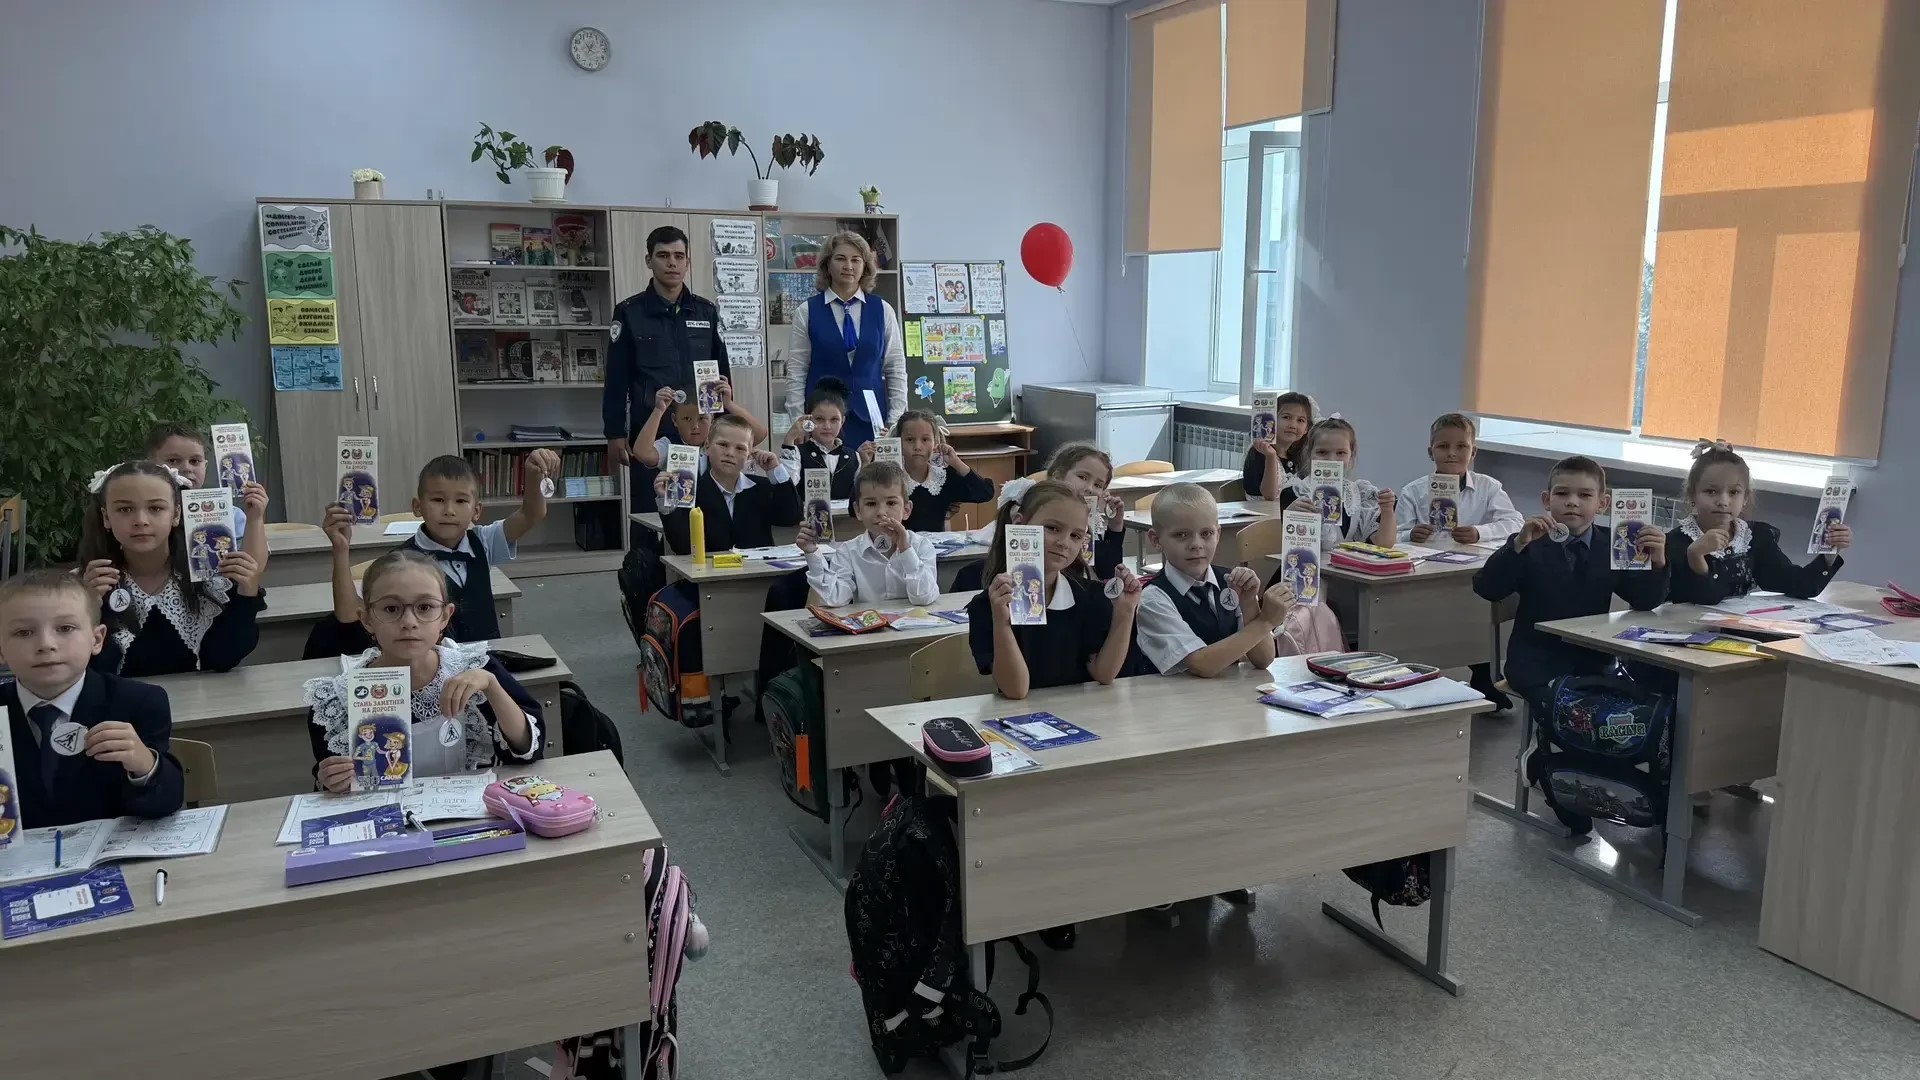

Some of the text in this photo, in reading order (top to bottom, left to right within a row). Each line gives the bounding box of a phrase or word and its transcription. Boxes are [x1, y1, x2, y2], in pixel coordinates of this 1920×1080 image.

[353, 698, 405, 708] СТАНЬ ЗАМЕТНЕЙ
[372, 705, 397, 713] ДОРОГЕ!
[1600, 722, 1645, 738] RACING
